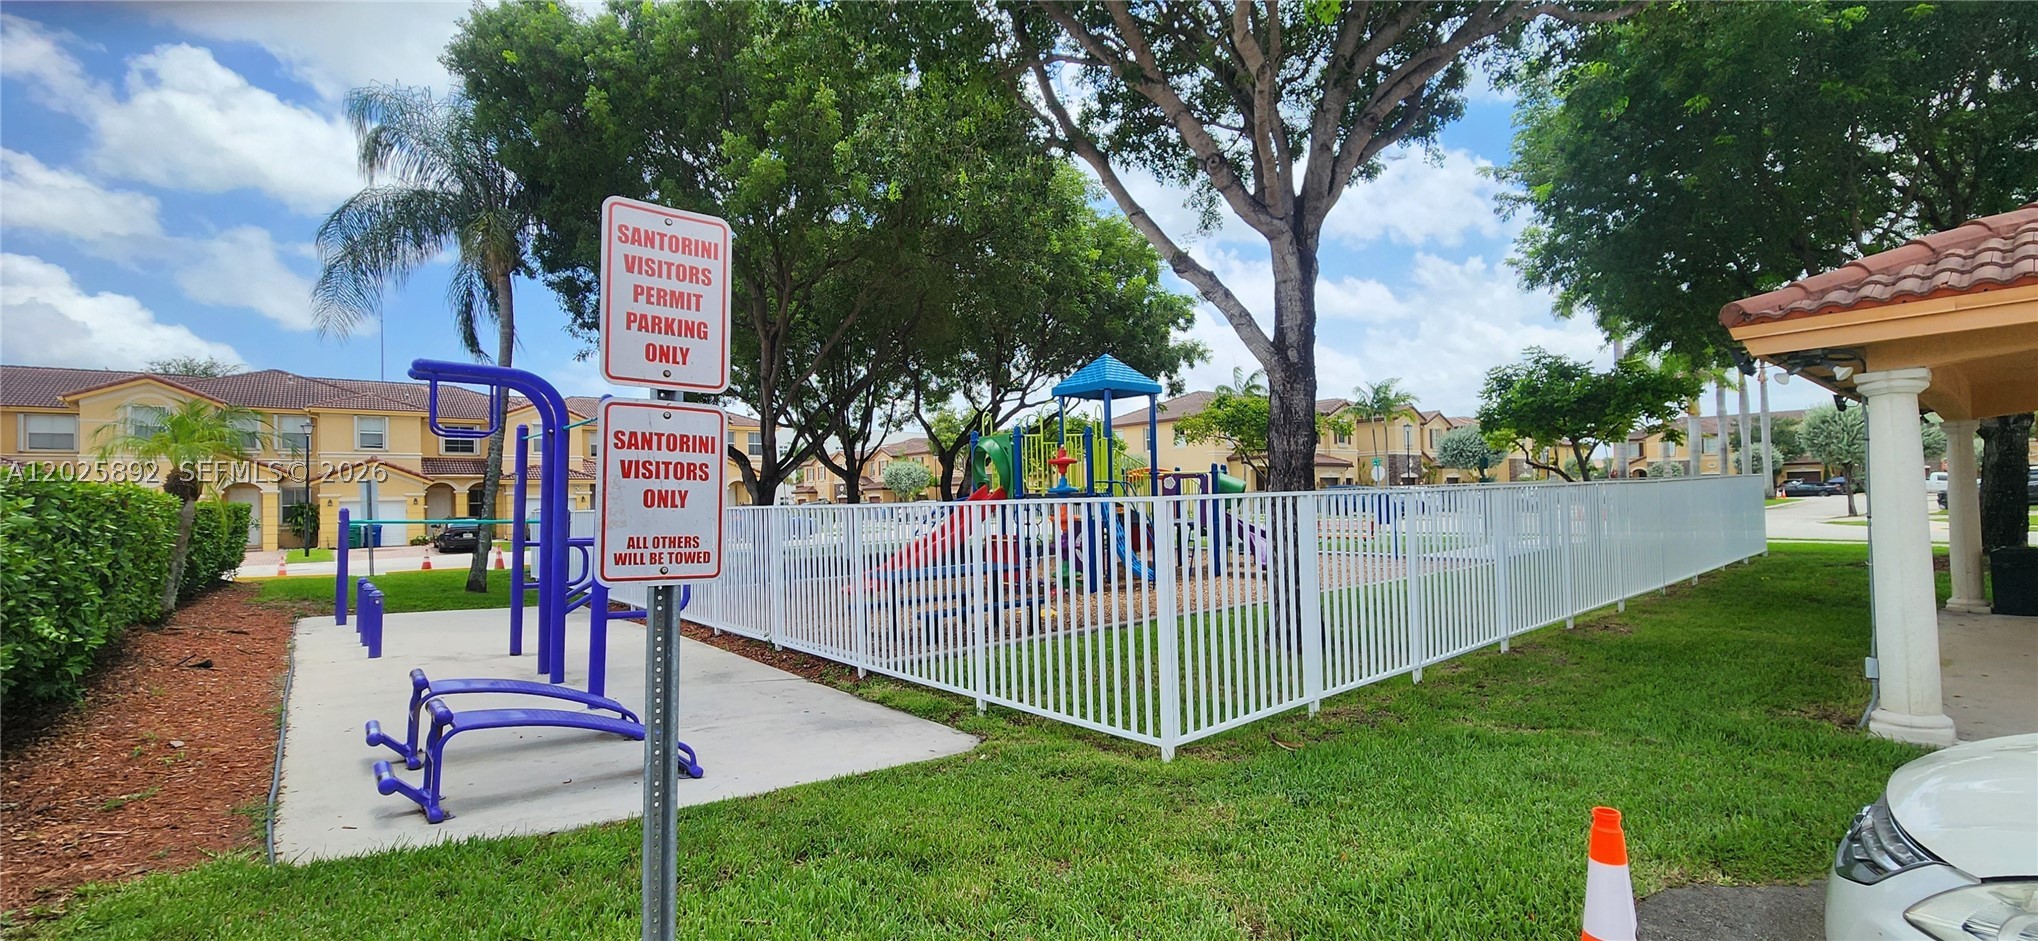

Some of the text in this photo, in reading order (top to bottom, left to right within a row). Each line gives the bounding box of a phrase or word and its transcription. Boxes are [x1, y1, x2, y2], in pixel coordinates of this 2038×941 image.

[617, 224, 719, 260] SANTORINI
[623, 253, 712, 287] VISITORS
[632, 283, 703, 312] PERMIT
[625, 311, 708, 340] PARKING
[644, 343, 690, 366] ONLY
[613, 430, 716, 454] SANTORINI
[619, 459, 710, 481] VISITORS
[642, 488, 689, 508] ONLY
[626, 535, 700, 550] ALL OTHERS
[613, 551, 711, 566] WILL BE TOWED
